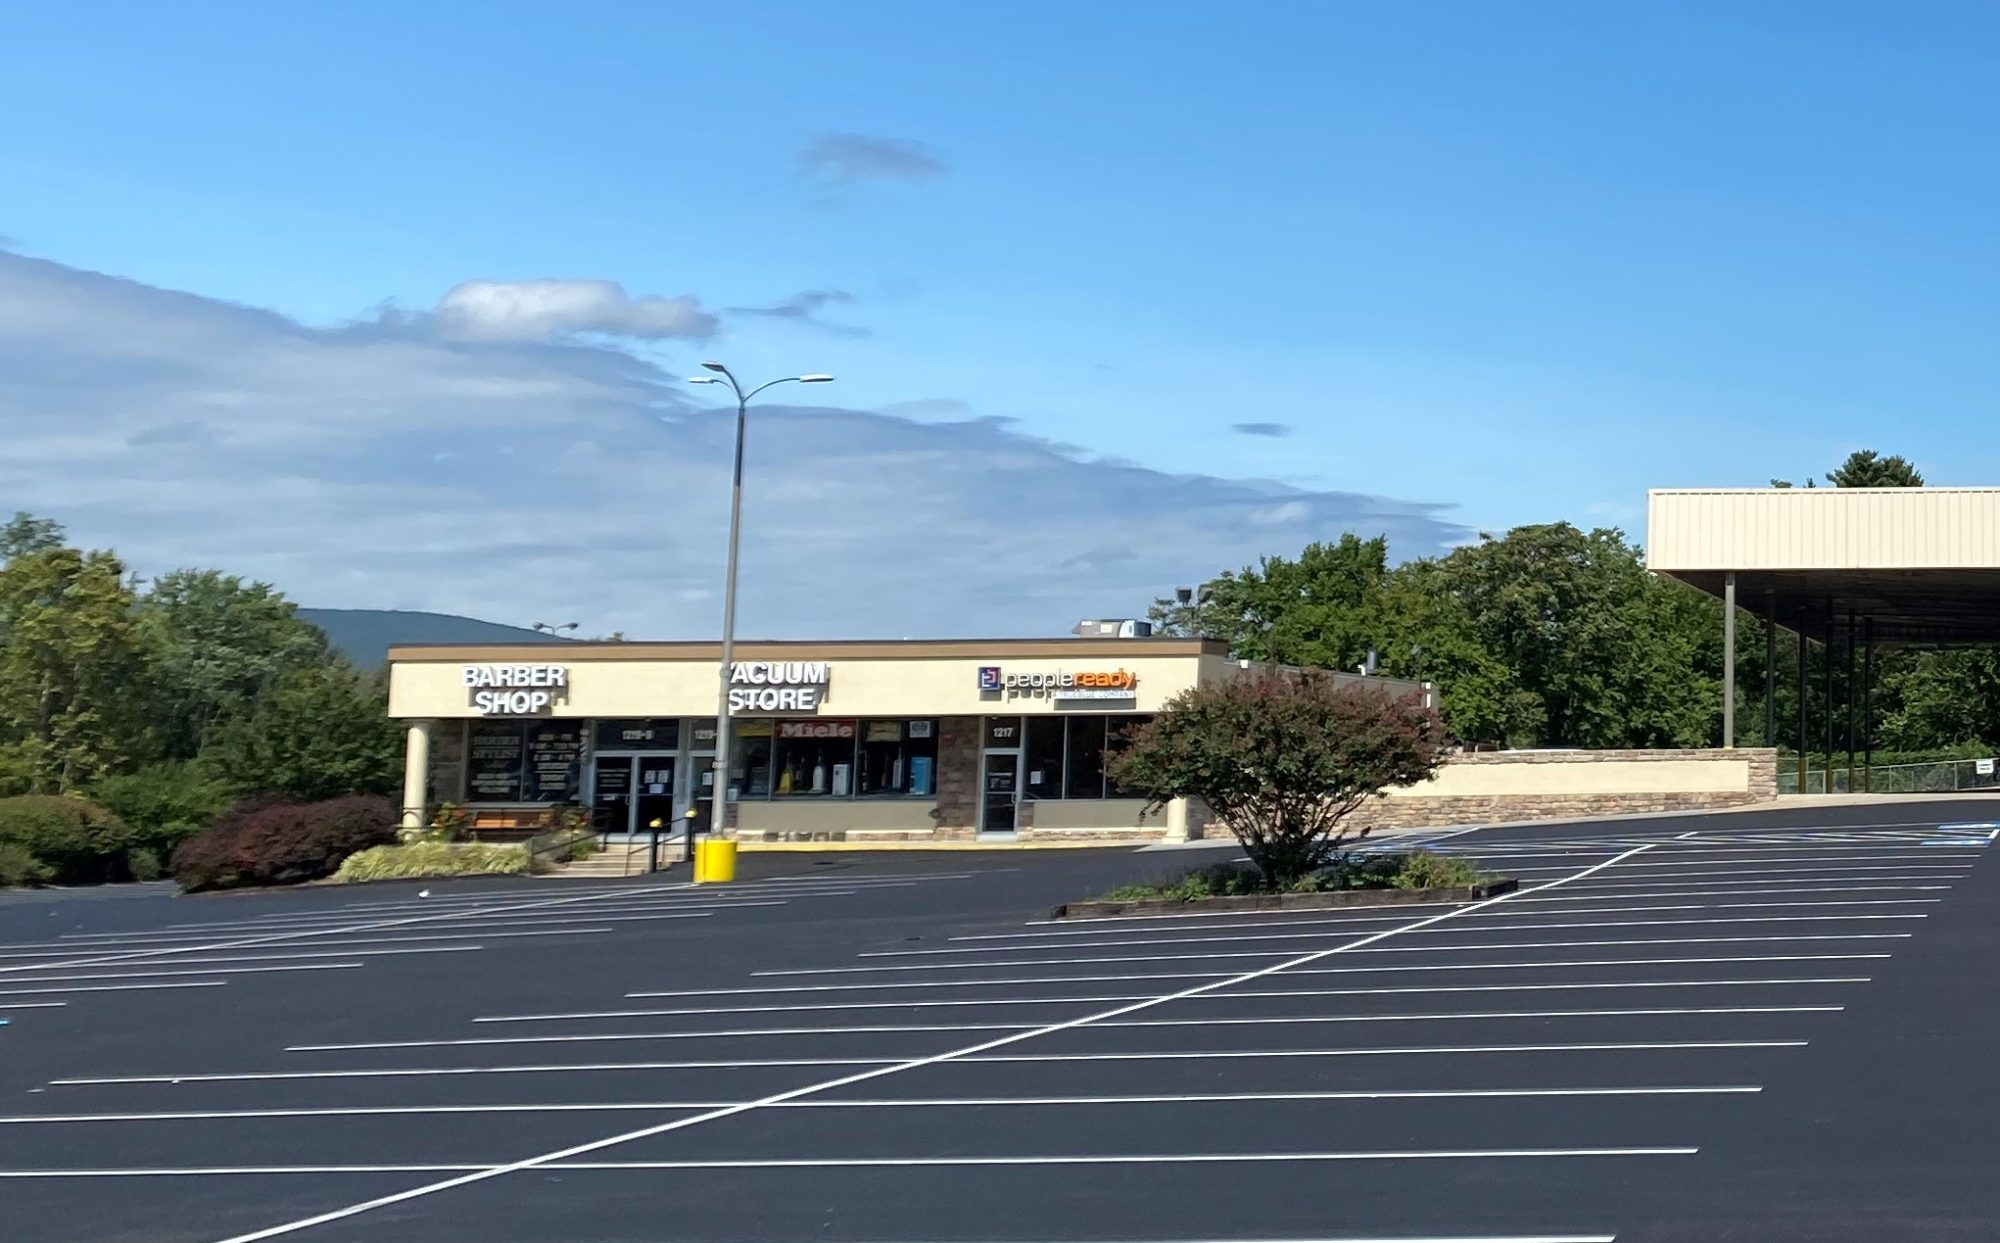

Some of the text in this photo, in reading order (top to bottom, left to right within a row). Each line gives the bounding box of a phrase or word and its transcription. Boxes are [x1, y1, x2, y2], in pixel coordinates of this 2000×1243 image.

[462, 665, 565, 688] BARBER
[728, 662, 827, 684] ACUUM
[1005, 668, 1136, 692] peopleready
[475, 691, 549, 714] SHOP
[728, 688, 816, 711] STORE
[779, 723, 853, 738] Miele
[993, 727, 1013, 738] 1217
